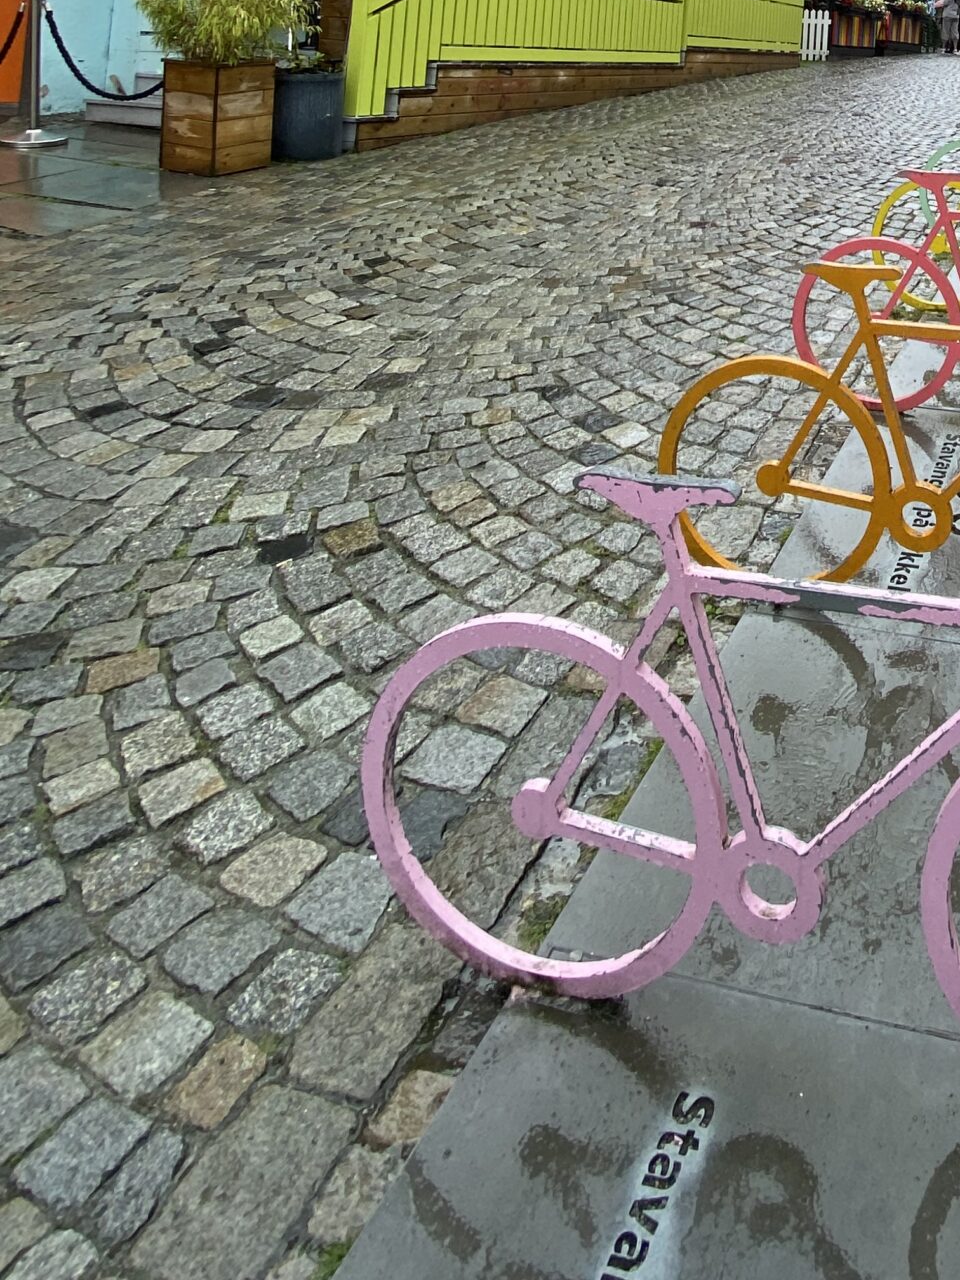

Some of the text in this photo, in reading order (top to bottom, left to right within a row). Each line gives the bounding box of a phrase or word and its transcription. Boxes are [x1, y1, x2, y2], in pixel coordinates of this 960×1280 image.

[912, 507, 935, 529] på
[887, 552, 923, 592] kkel
[600, 1091, 715, 1280] Stava
